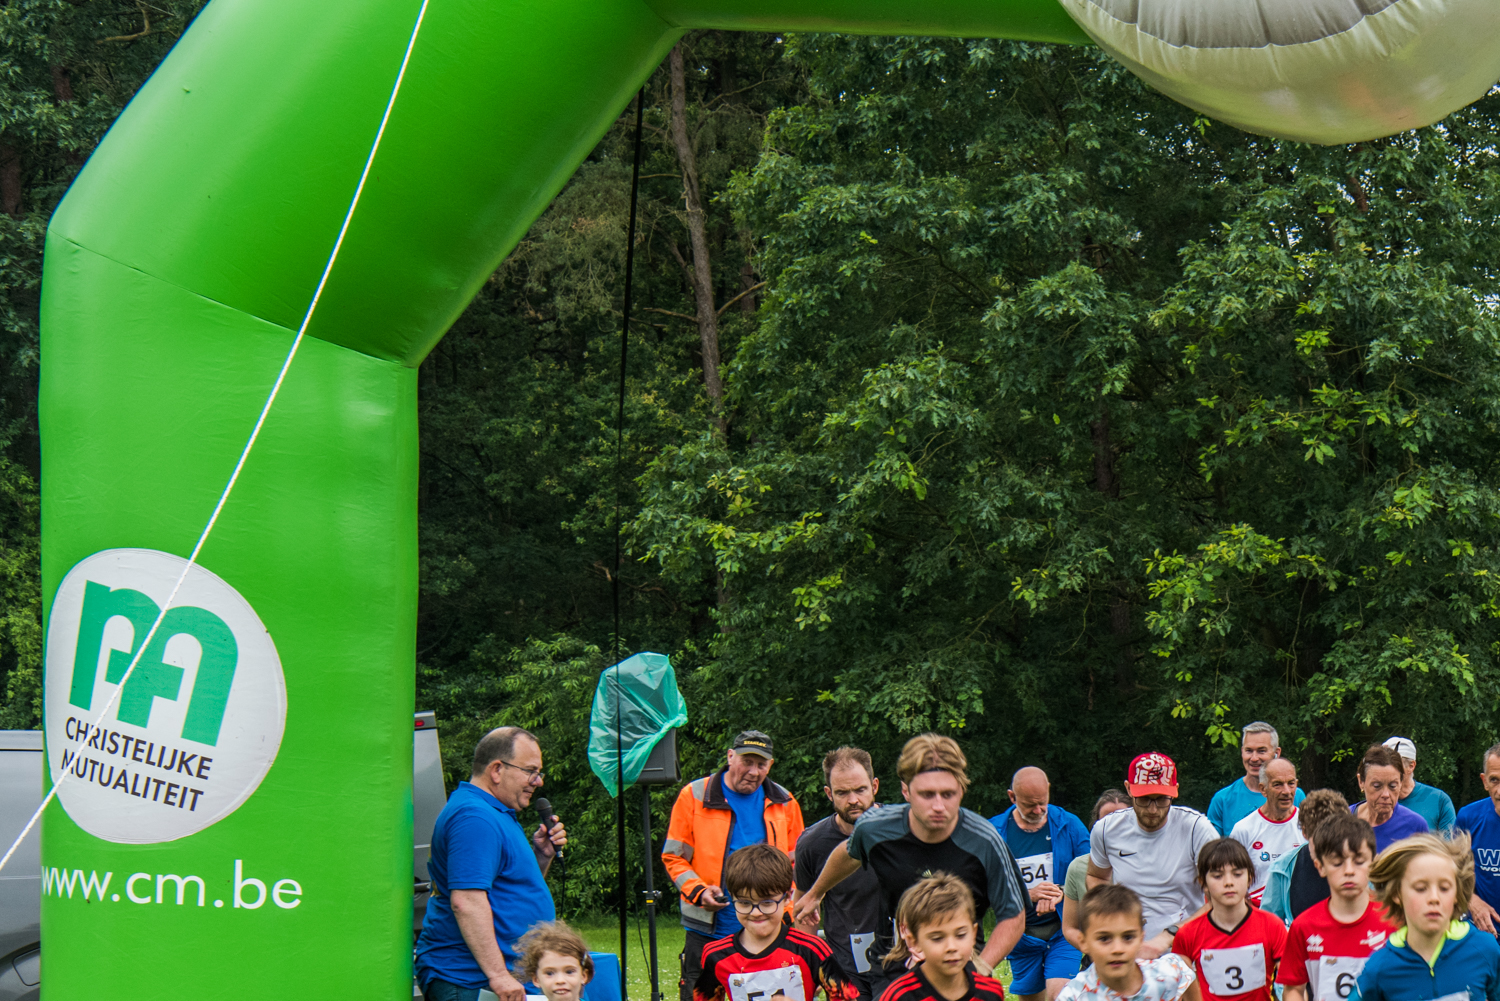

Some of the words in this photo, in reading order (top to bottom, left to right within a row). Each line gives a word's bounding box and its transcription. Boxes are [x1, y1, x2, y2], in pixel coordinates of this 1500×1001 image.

[65, 717, 213, 781] CHRISTELIJKE
[61, 752, 204, 812] MUTUALITEIT
[41, 860, 303, 910] www.cm.be
[1021, 863, 1049, 883] 54
[1225, 966, 1244, 990] 3
